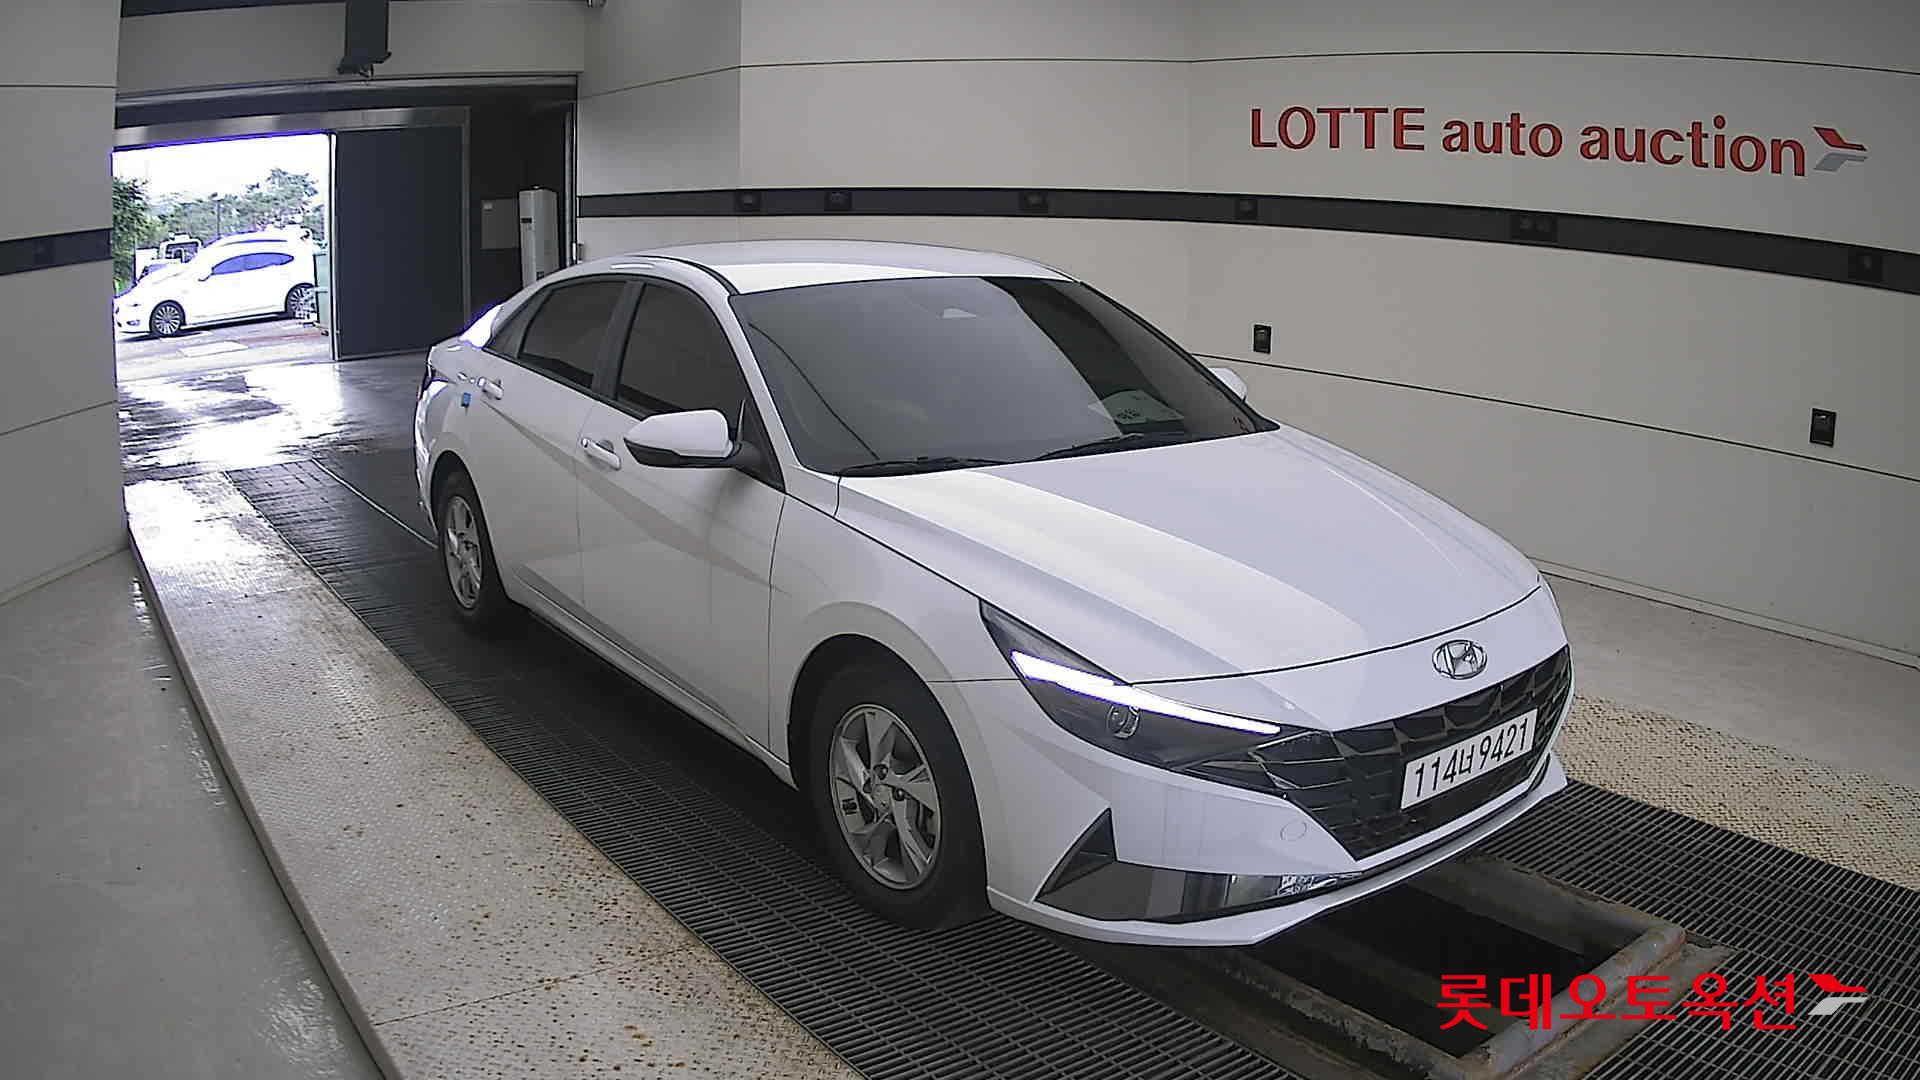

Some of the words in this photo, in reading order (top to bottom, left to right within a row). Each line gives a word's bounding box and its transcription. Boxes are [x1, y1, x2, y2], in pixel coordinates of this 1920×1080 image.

[1251, 107, 1425, 150] LOTTE
[1442, 112, 1563, 158] auto
[1580, 115, 1806, 176] auction
